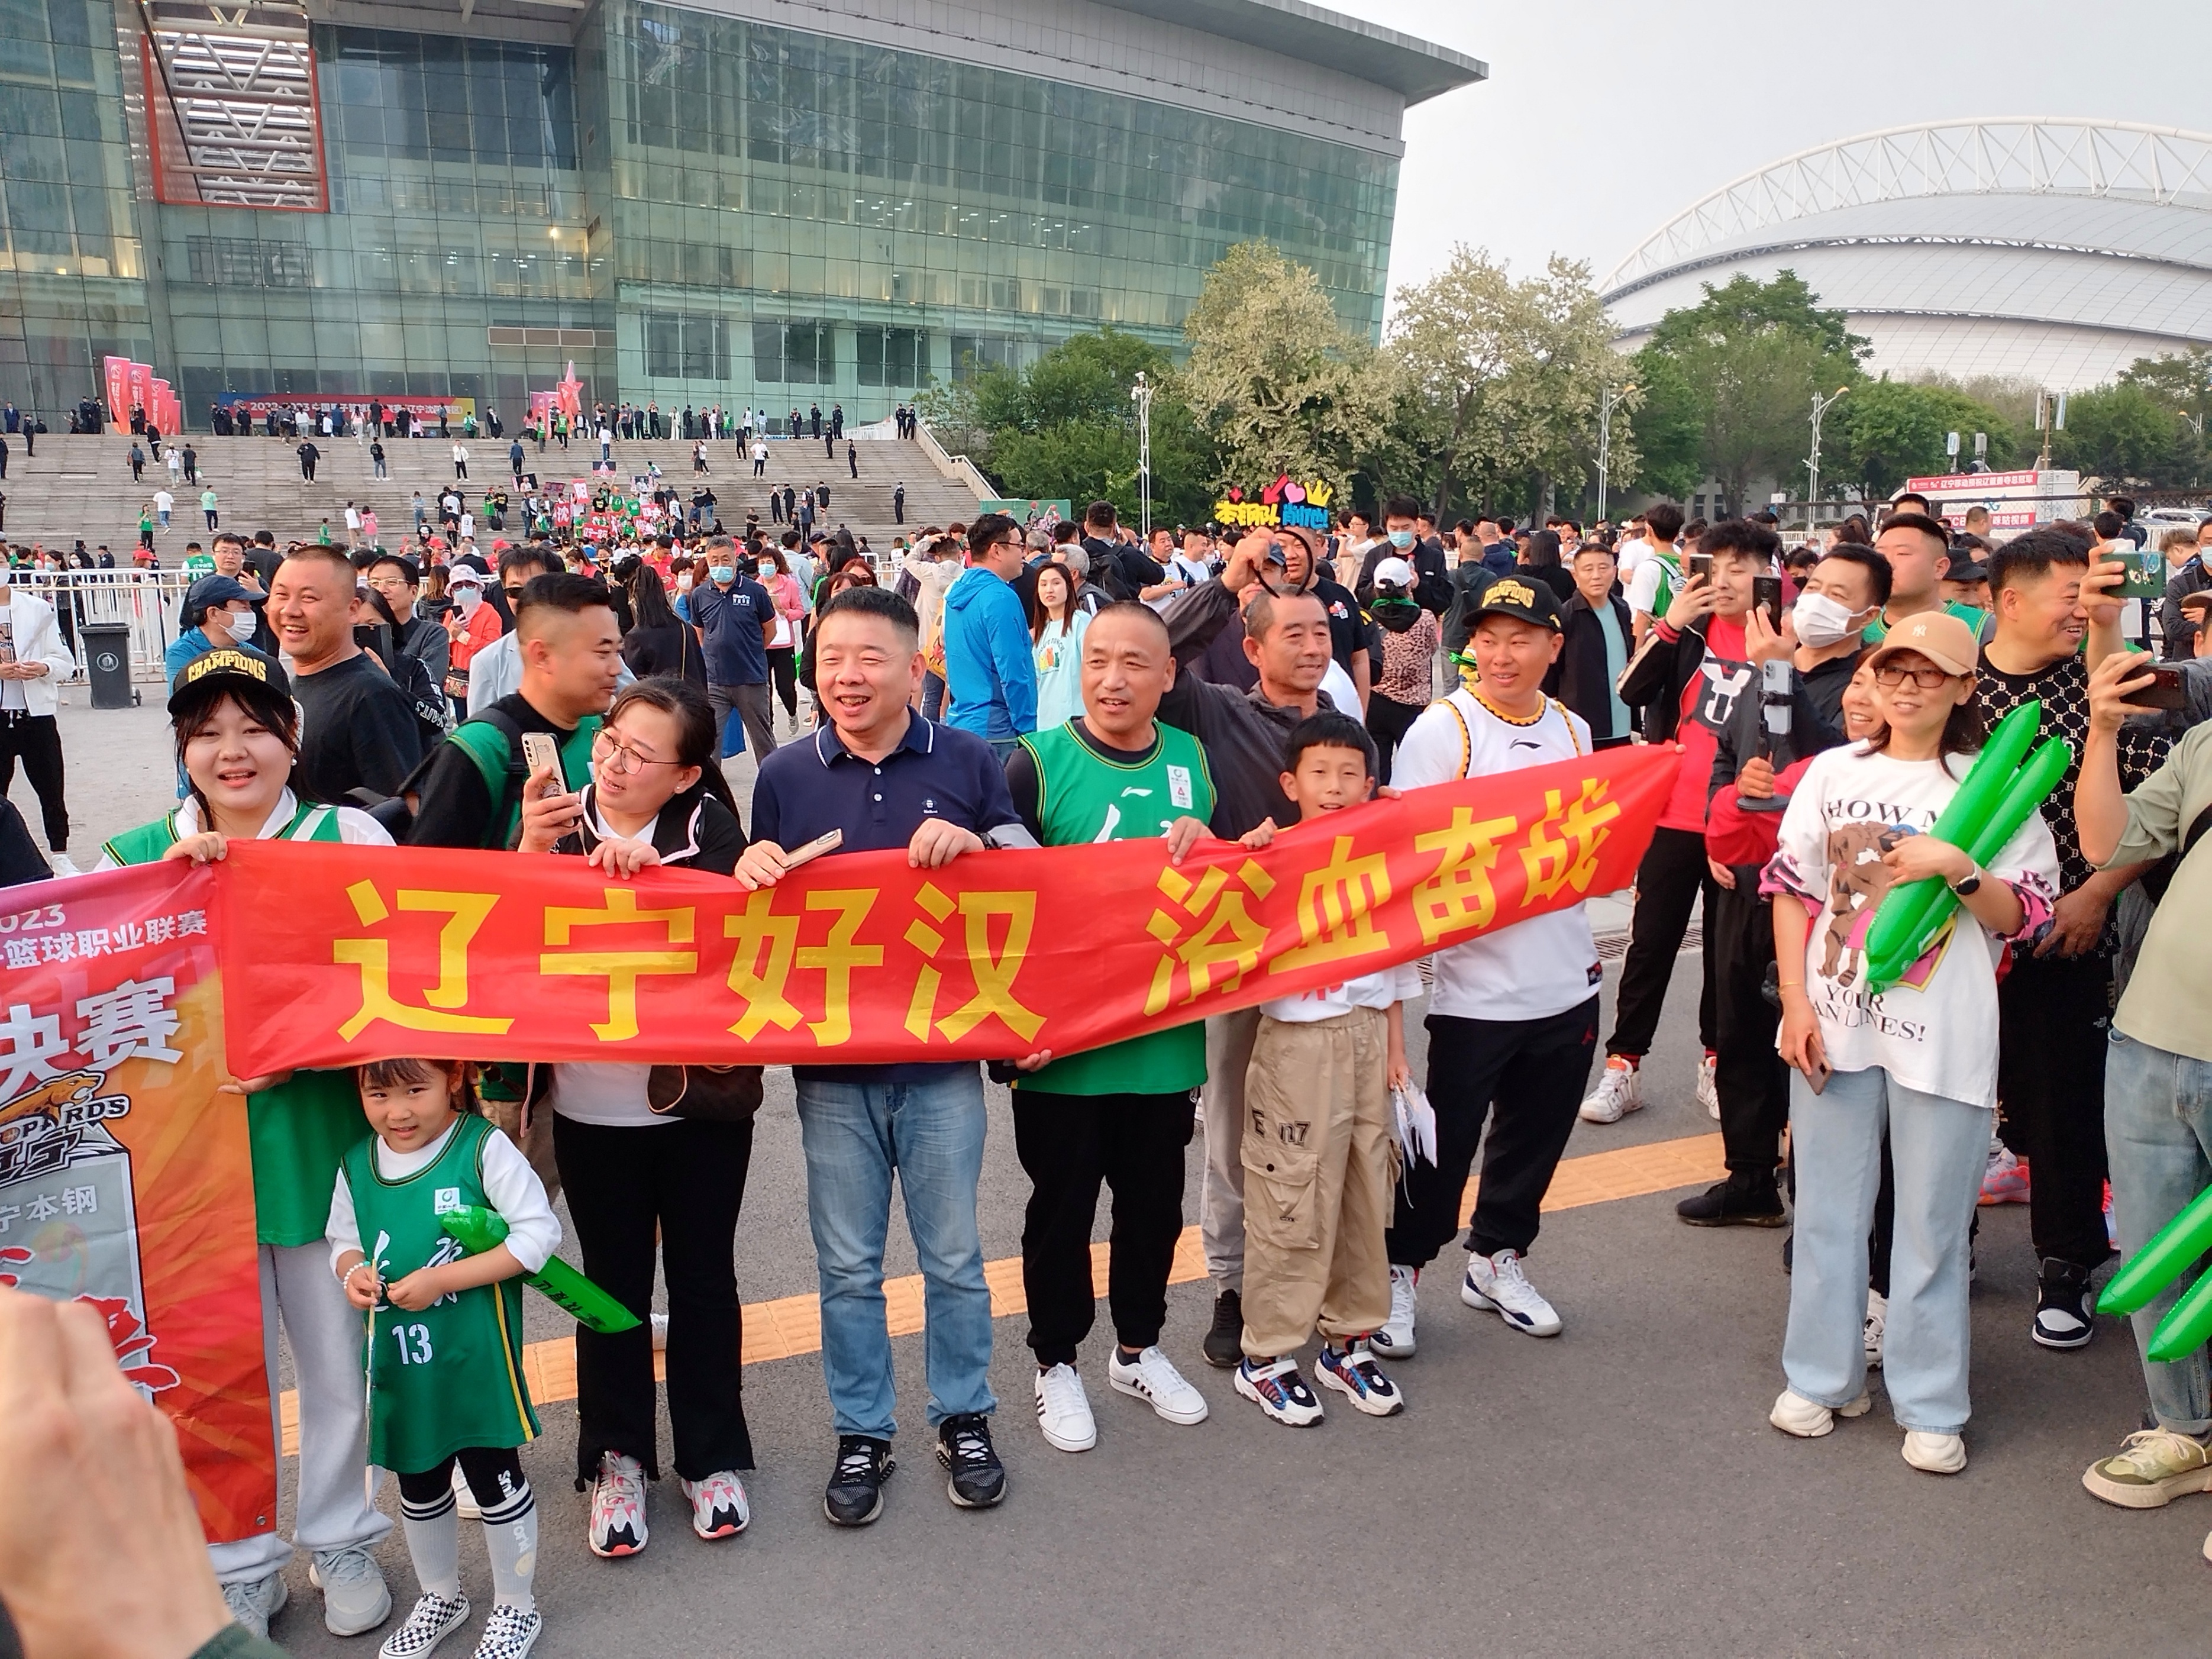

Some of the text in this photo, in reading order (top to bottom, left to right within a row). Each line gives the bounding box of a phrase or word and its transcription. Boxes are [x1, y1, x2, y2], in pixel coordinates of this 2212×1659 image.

[188, 655, 267, 682] CHAMPIONS
[333, 778, 1622, 1047] 辽宁好汉 浴血奋战
[1826, 983, 1884, 1012] YOUR
[392, 1324, 433, 1365] 13
